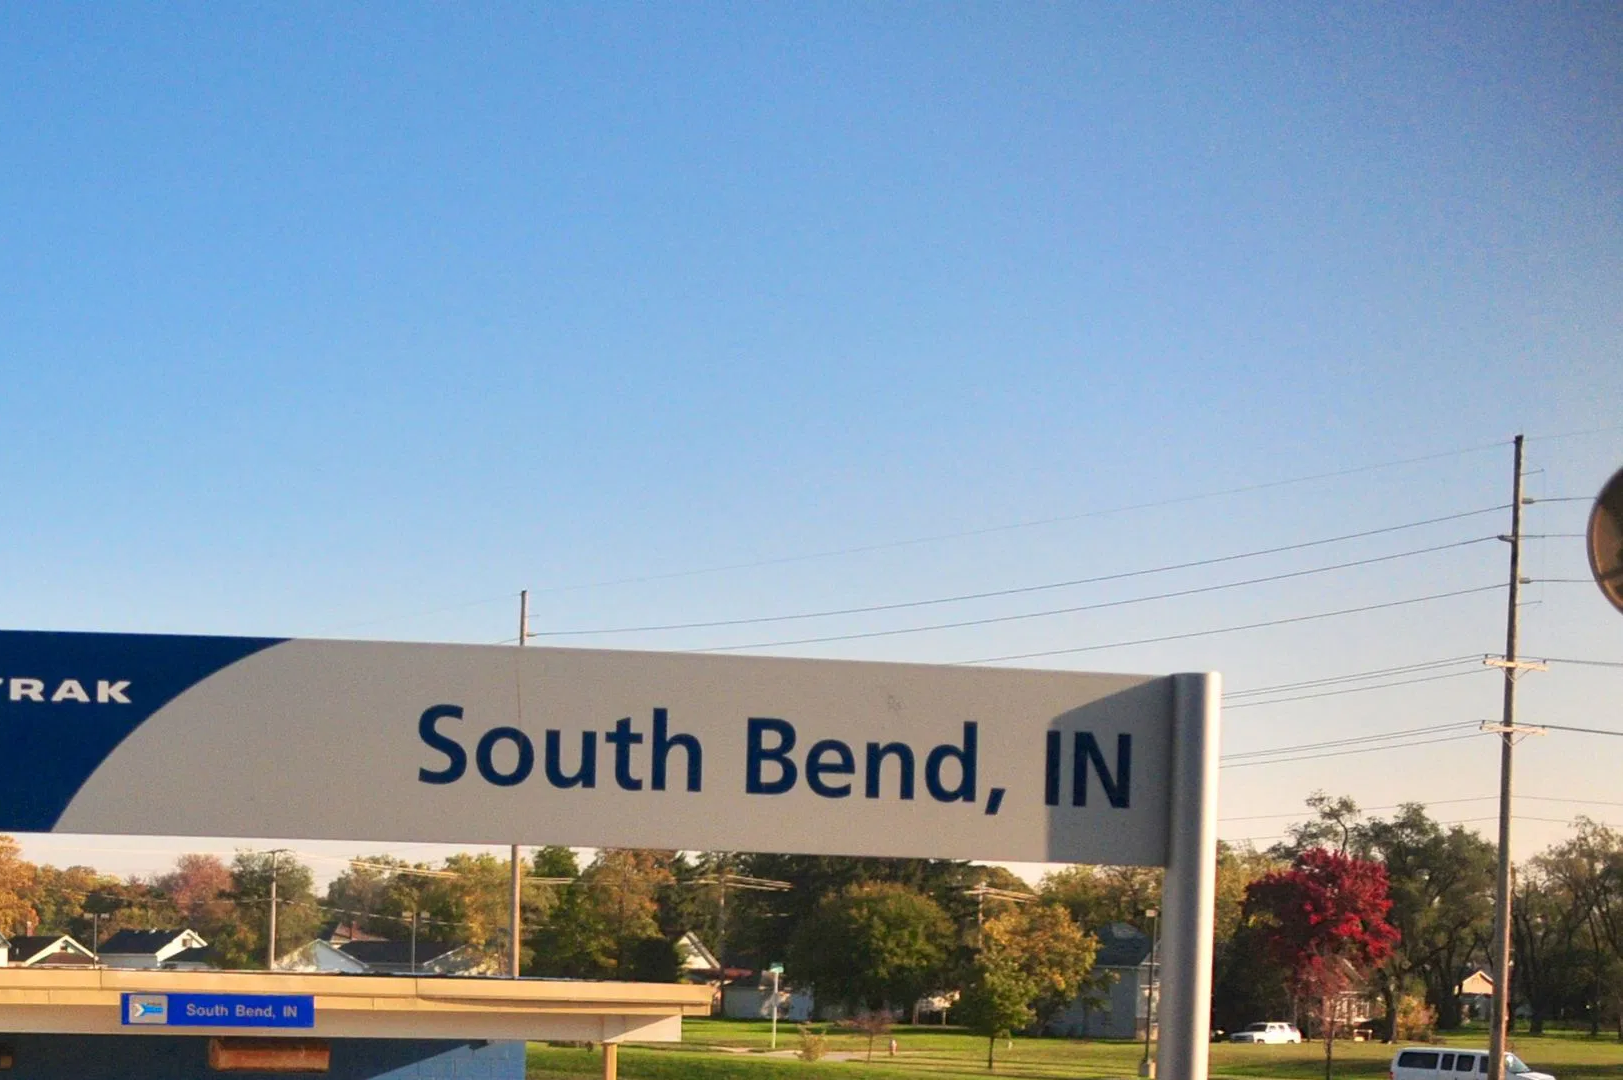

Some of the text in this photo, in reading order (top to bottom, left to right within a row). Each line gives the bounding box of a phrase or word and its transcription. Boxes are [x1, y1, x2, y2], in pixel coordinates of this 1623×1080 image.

[417, 703, 1132, 816] South Bend, IN
[185, 1003, 298, 1020] South Bend, IN
